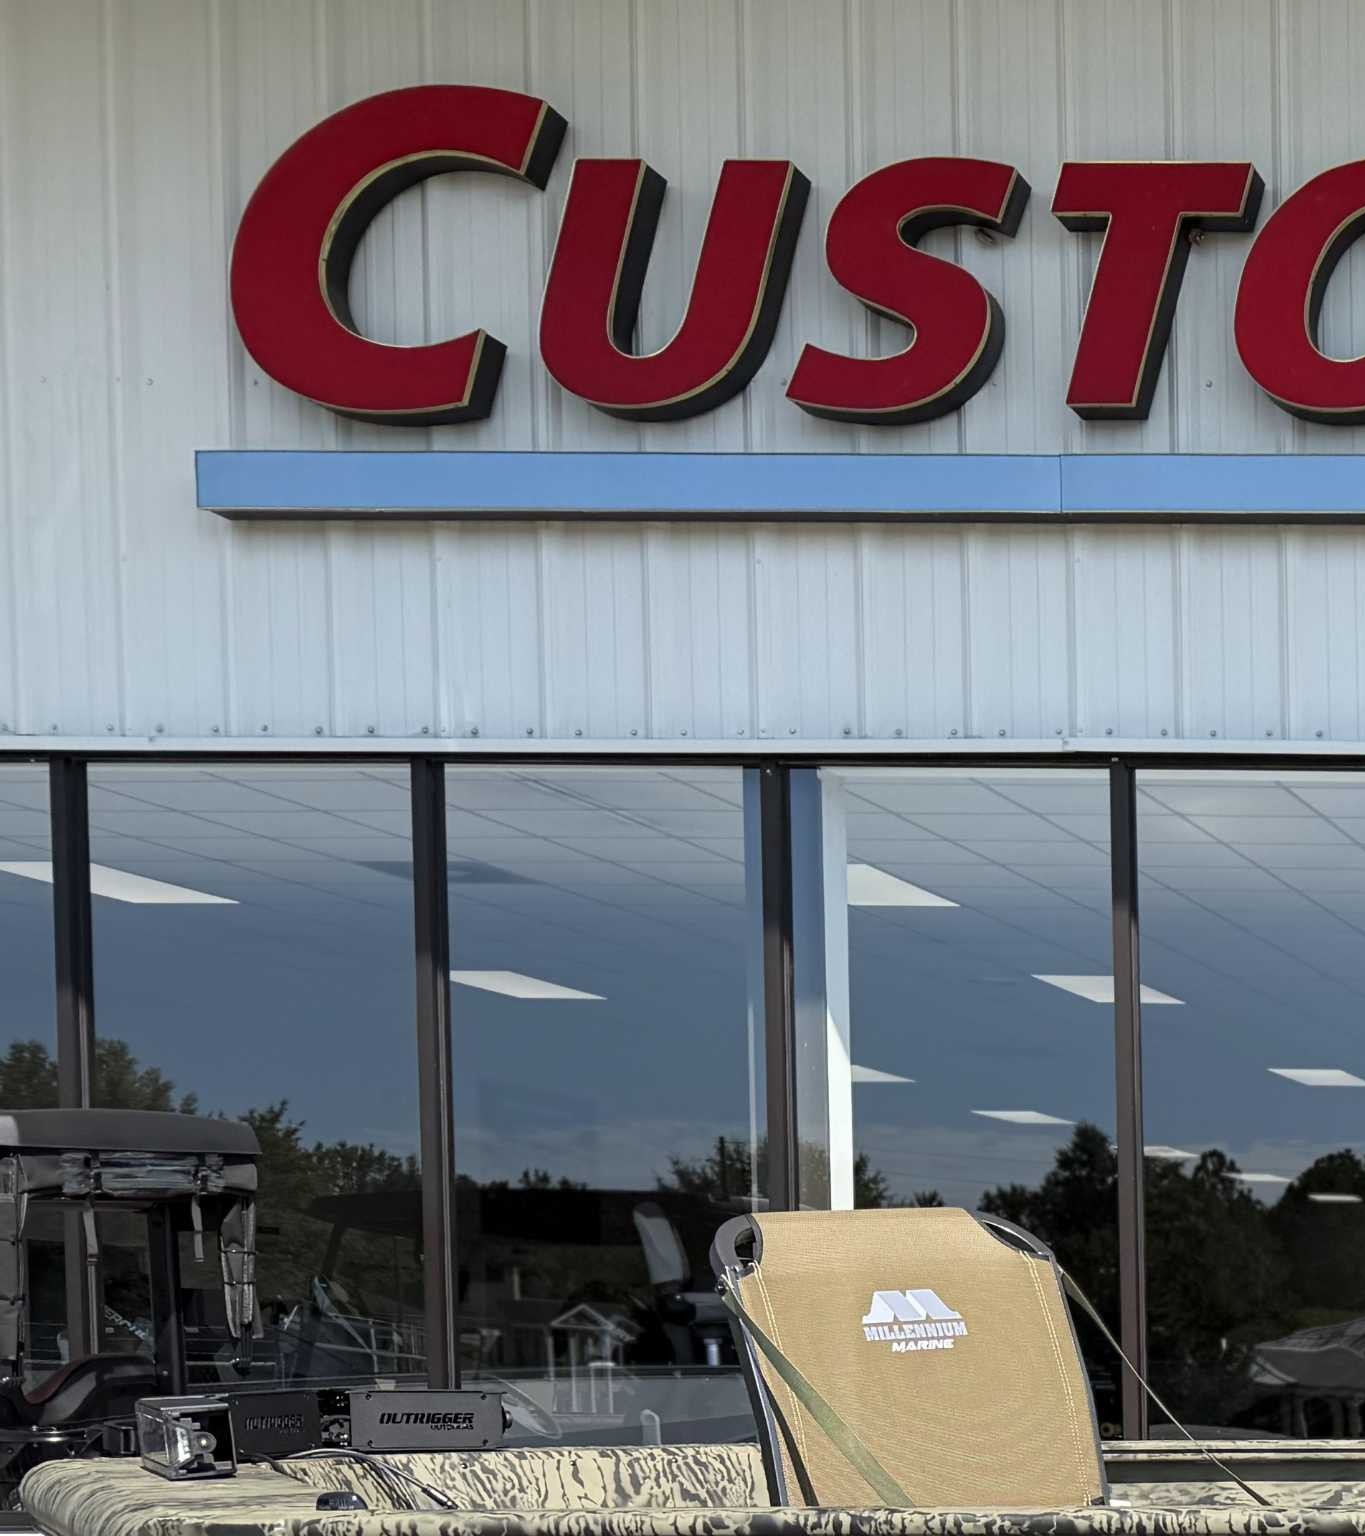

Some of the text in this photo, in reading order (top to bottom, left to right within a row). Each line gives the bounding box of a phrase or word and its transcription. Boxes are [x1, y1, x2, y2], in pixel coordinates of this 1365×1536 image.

[863, 1321, 968, 1341] MILLENNIUM
[892, 1339, 954, 1353] MARINE
[380, 1412, 475, 1424] OUTRIGGER
